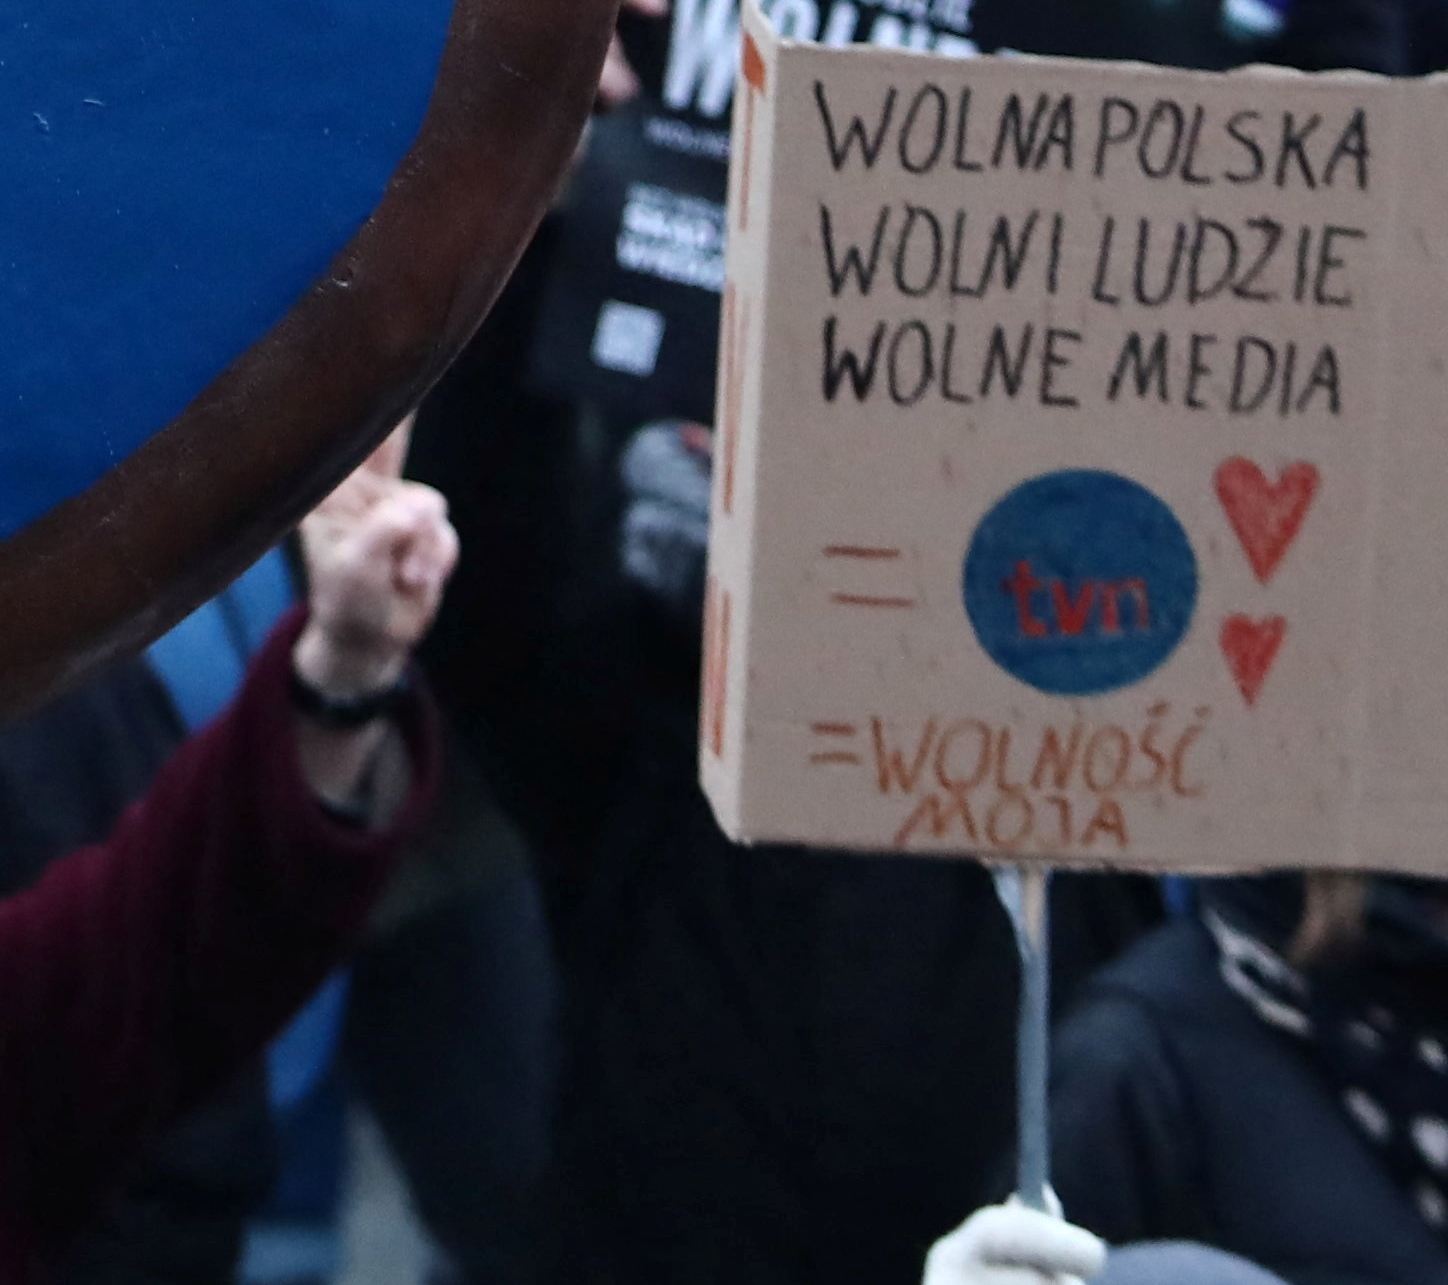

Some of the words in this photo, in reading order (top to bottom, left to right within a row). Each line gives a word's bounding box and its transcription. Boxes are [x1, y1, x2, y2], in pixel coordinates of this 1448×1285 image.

[813, 79, 1075, 175] WOLNA
[1092, 96, 1372, 191] POLSKA
[818, 201, 1065, 297] WOLNI
[1090, 214, 1367, 307] LUDZIE
[822, 314, 1084, 407] WOLNE
[1106, 330, 1342, 416] MEDIA
[999, 560, 1151, 637] tvn
[893, 783, 1131, 850] MOJA
